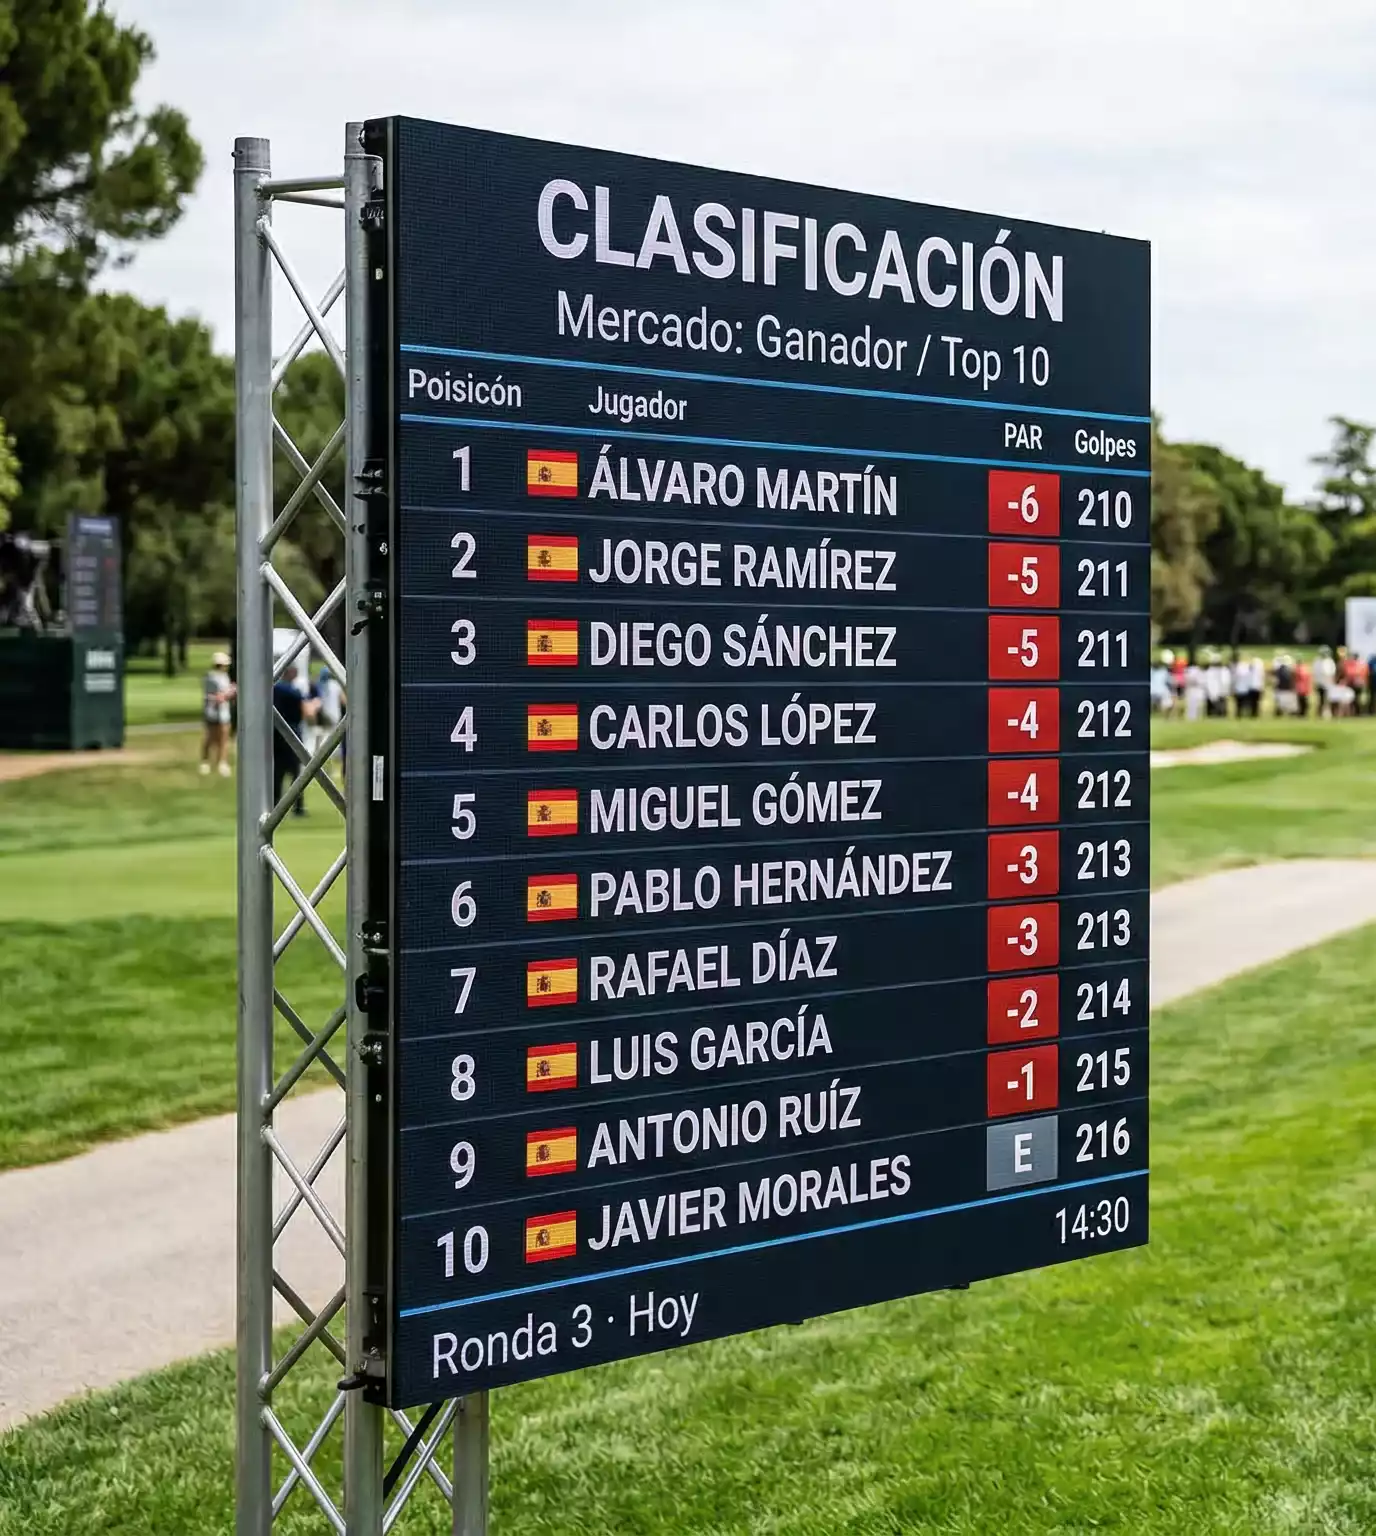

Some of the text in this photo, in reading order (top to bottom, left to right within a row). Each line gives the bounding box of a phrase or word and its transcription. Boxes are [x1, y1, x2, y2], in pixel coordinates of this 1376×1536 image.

[538, 178, 1065, 323] CLASIFICACIÓN
[556, 289, 1050, 391] Mercado: Ganador / Top 10
[408, 368, 1137, 463] Poisicón Jugador PAR Golpes
[452, 445, 1132, 529] 1 ÁLVARO MARTÍN -6 210
[450, 532, 1128, 597] 2 JORGE RAMÍREZ -5 211
[450, 613, 1128, 668] 3 DIEGO SÁNCHEZ -5 211
[450, 692, 1132, 752] 4 CARLOS LÓPEZ -4 212
[451, 769, 1132, 840] 5 MIGUEL GÓMEZ -4 212
[451, 839, 1131, 928] 6 PABLO HERNÁNDEZ -3 213
[450, 908, 1131, 1014] 7 RAFAEL DÍAZ -3 213
[450, 978, 1131, 1101] 8 LUIS GARCÍA -2 214
[449, 1047, 1131, 1190] 9 ANTONIO RUÍZ -1 215
[436, 1117, 1130, 1278] 10 JAVIER MORALES E 216
[1055, 1195, 1130, 1244] 14:30
[431, 1312, 558, 1379] Ronda
[571, 1303, 593, 1348] 3
[629, 1291, 699, 1337] Hoy
